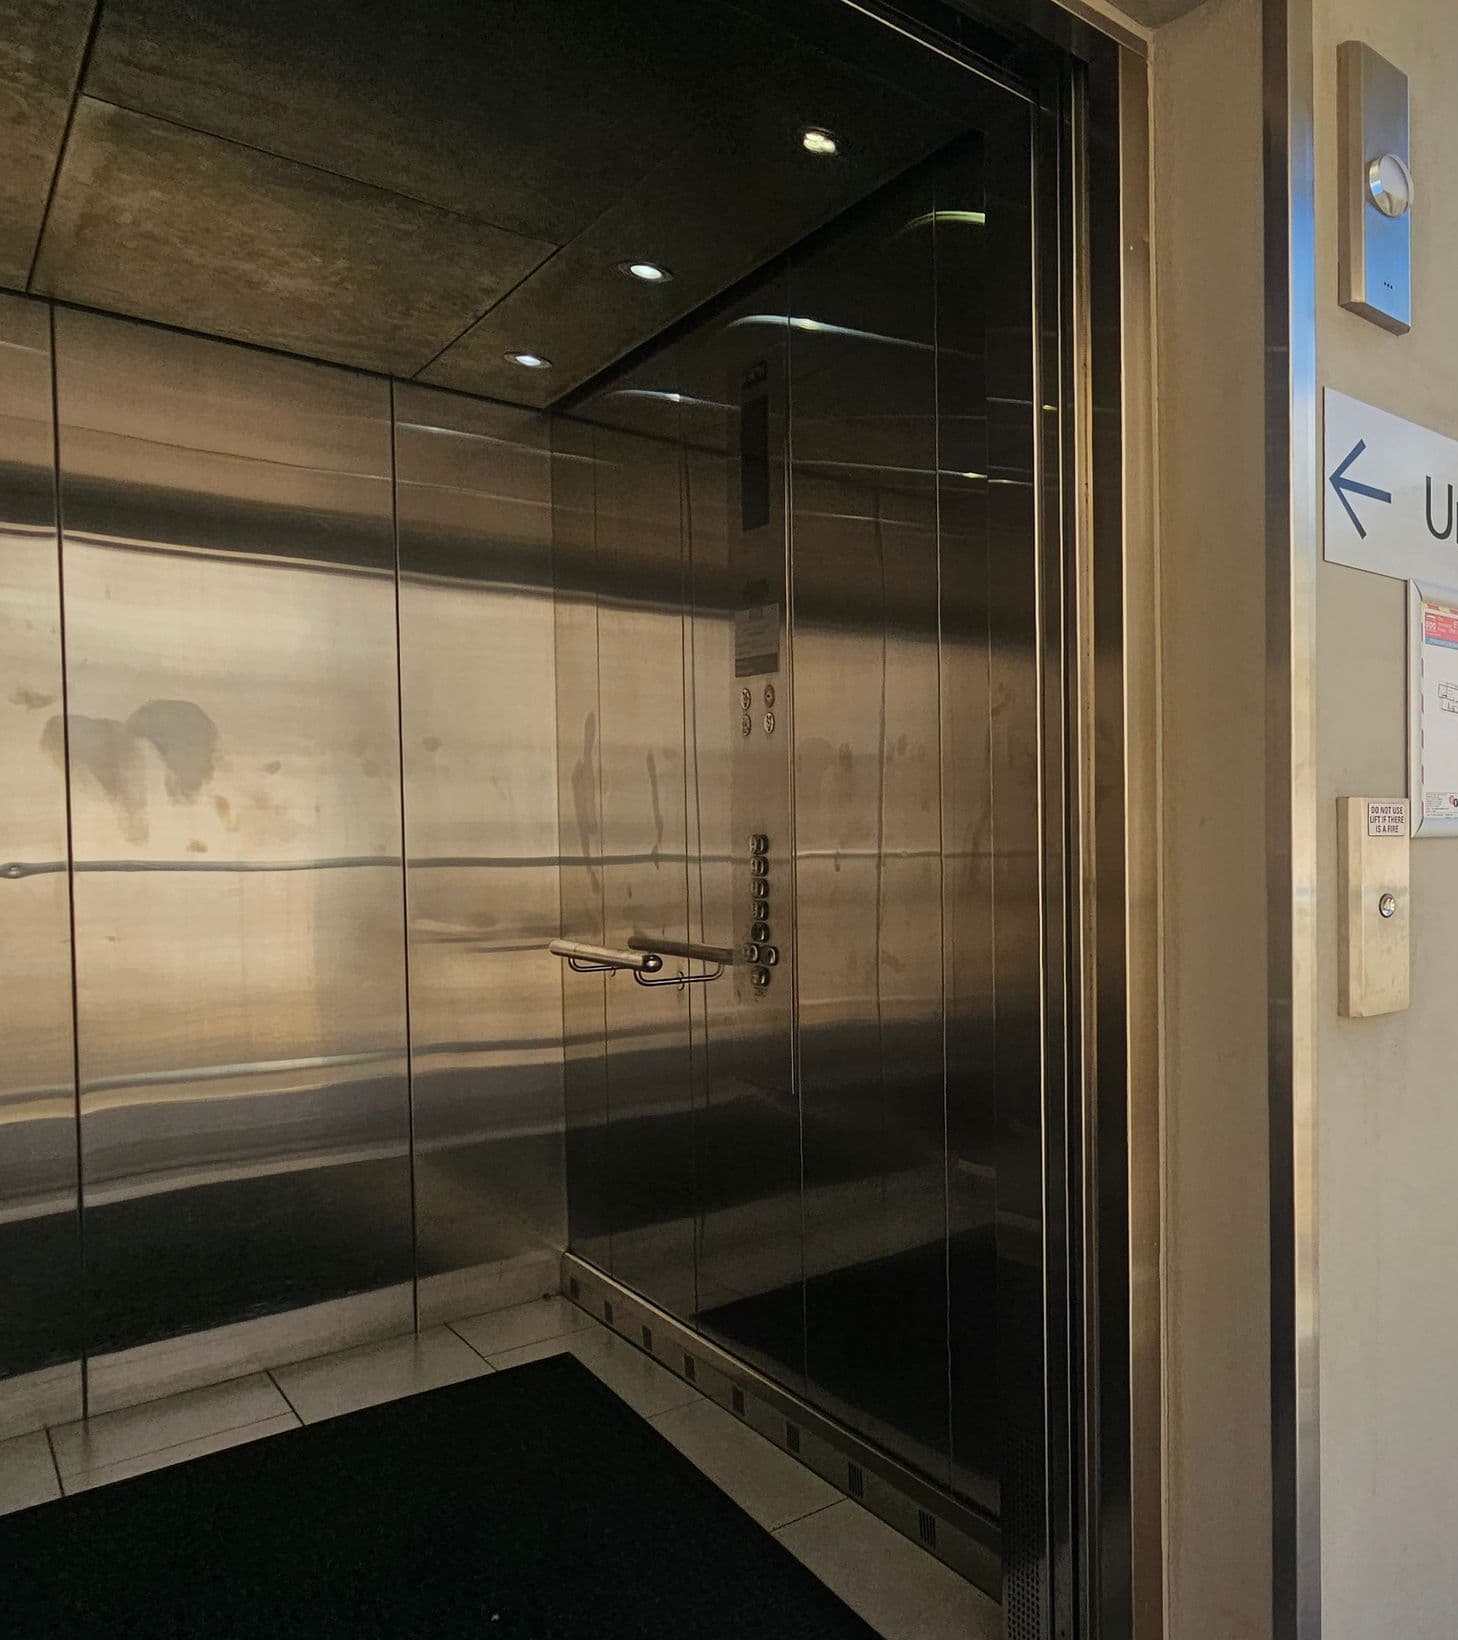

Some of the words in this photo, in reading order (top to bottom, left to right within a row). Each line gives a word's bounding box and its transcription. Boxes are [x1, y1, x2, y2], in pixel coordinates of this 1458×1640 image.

[1371, 806, 1379, 814] DO
[1380, 806, 1391, 814] NOT
[1392, 806, 1403, 815] USE
[1376, 825, 1381, 833] IS
[1382, 825, 1387, 833] A
[1387, 825, 1399, 833] FIRE
